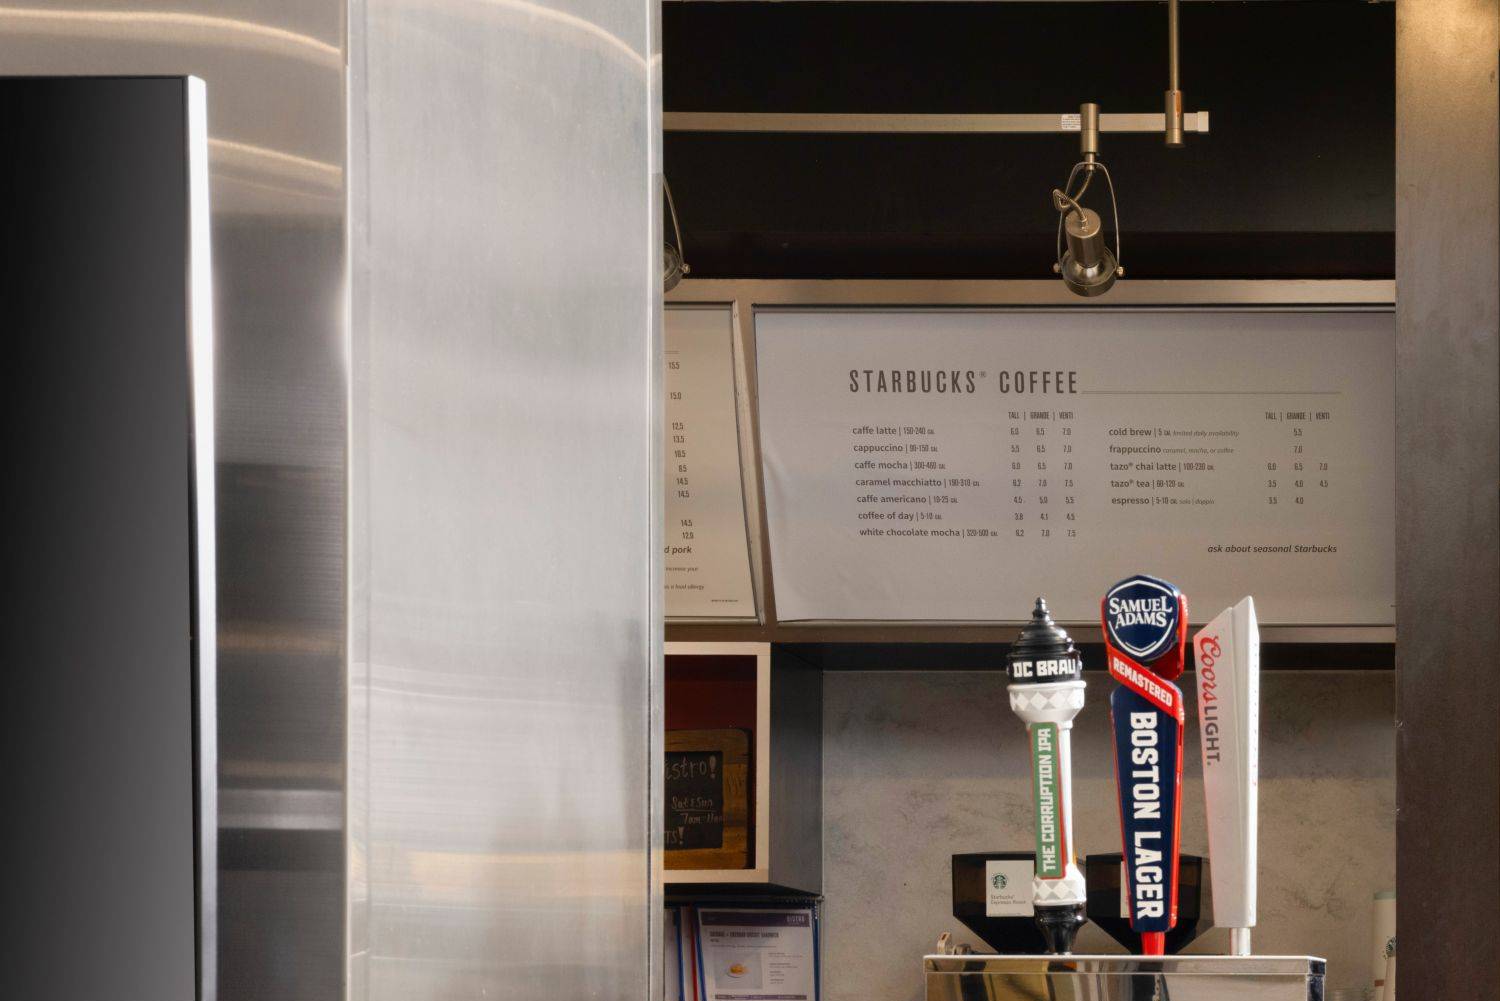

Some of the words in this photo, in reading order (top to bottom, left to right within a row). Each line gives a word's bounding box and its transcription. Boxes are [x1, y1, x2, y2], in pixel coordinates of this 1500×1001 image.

[999, 370, 1077, 394] COFFEE
[1008, 411, 1020, 420] TALL
[1030, 411, 1050, 420] GRANDE
[1059, 411, 1074, 420] VENTI
[1265, 412, 1276, 420] TALL
[1286, 412, 1306, 420] GRANDE
[1315, 412, 1330, 420] VENTI
[852, 426, 874, 435] caffe
[876, 426, 897, 435] latte
[1108, 428, 1127, 436] cold
[1129, 428, 1152, 436] brew
[853, 444, 903, 453] cappuccino
[1109, 445, 1161, 454] frappuccino
[854, 461, 876, 469] caffe
[878, 461, 908, 469] mocha
[1135, 462, 1154, 471] chai
[1156, 462, 1177, 471] latte
[855, 478, 890, 486] caramel
[1136, 480, 1150, 488] tea
[856, 495, 878, 503] caffe
[880, 495, 926, 503] americano
[1111, 497, 1150, 506] espresso
[858, 512, 885, 520] coffee
[887, 512, 896, 520] of
[897, 512, 914, 521] day
[859, 528, 884, 537] white
[886, 528, 929, 537] chocolate
[931, 528, 960, 537] mocha
[672, 546, 692, 555] pork
[1207, 544, 1223, 553] ask
[1225, 544, 1251, 553] about
[1253, 544, 1292, 553] seasonal
[1293, 544, 1338, 553] Starbucks
[1109, 595, 1173, 616] SAMUEL
[1114, 610, 1168, 630] ADAMS
[1012, 660, 1033, 678] DC
[1036, 659, 1076, 677] BRAU
[1199, 634, 1222, 705] Coors
[1112, 656, 1174, 707] REMASTERED
[1036, 728, 1051, 763] IPA
[1130, 711, 1161, 820] BOSTON
[1038, 764, 1056, 839] CORRUPTION
[1042, 841, 1057, 873] THE
[1132, 831, 1162, 921] LAGER
